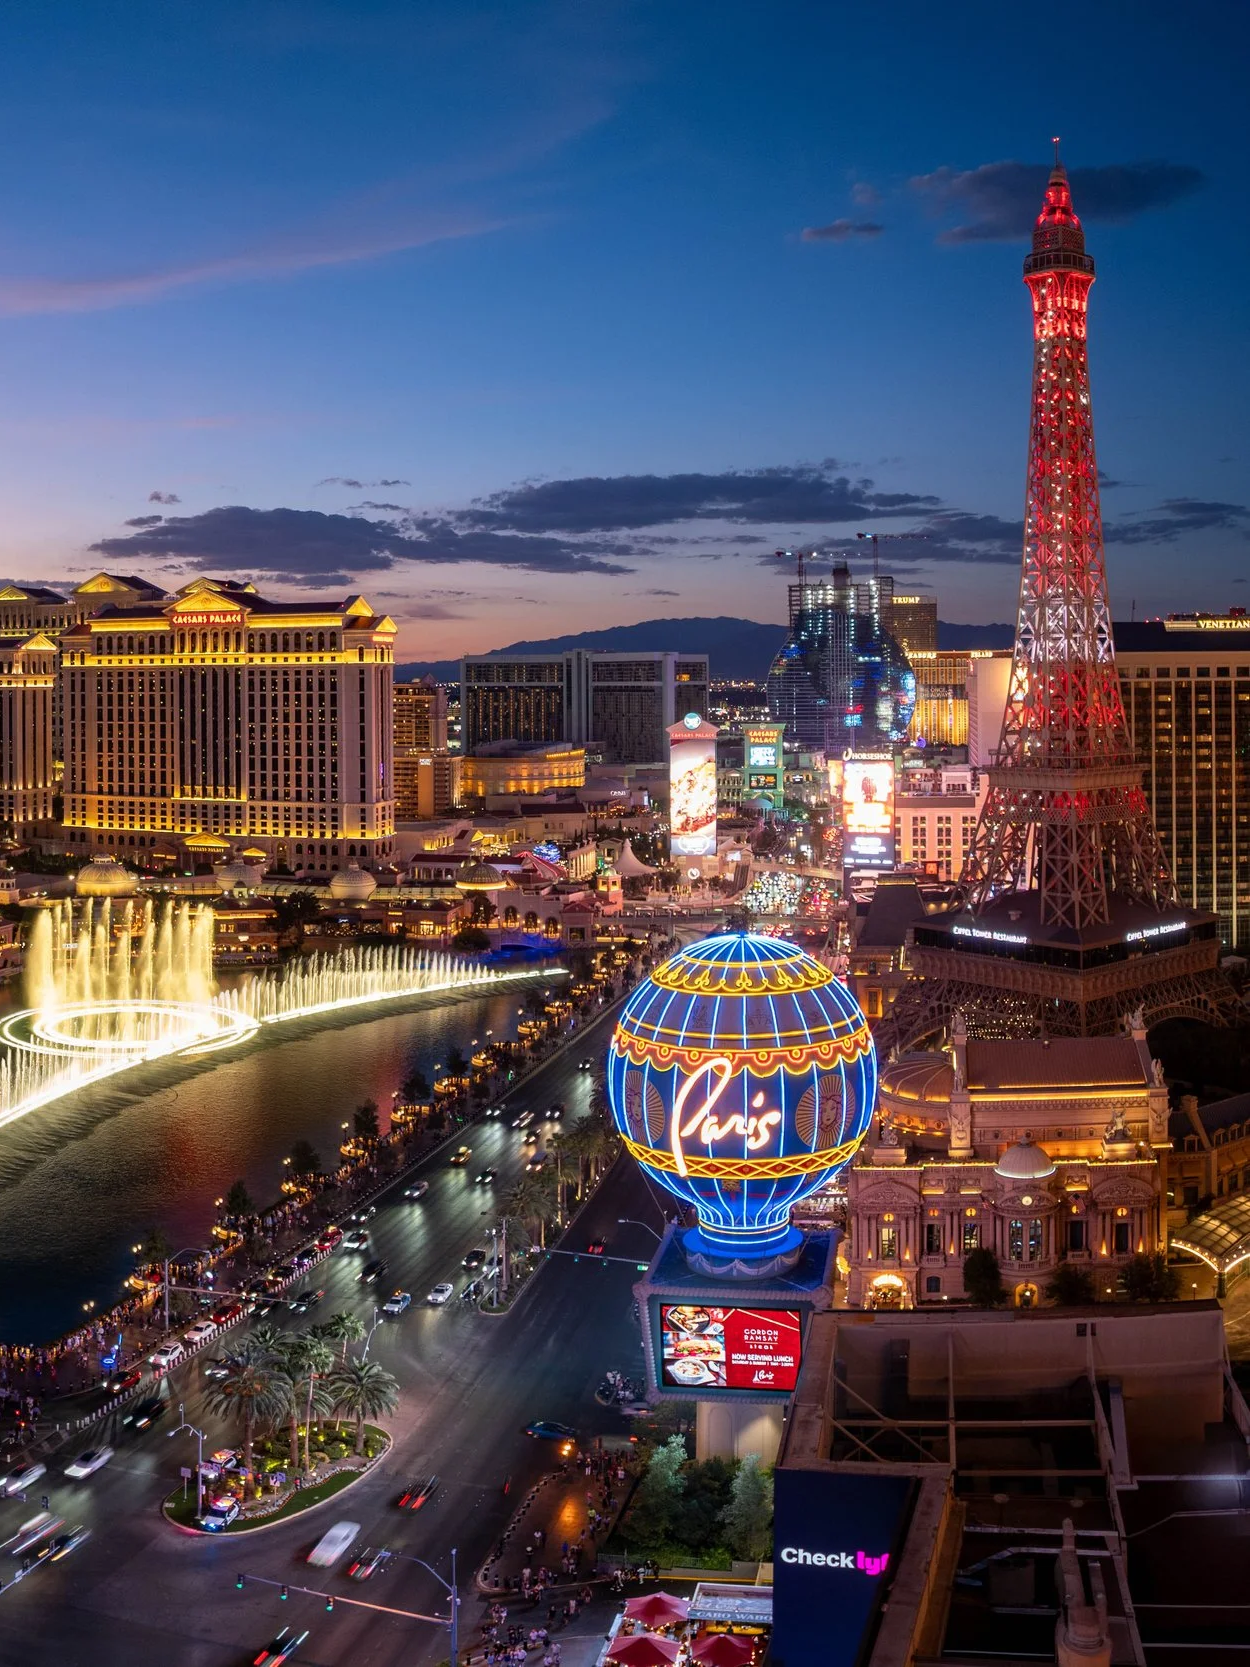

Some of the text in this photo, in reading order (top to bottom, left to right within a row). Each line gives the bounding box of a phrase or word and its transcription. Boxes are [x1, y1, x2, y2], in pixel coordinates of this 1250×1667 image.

[892, 596, 920, 604] TRUMP
[173, 614, 241, 624] CAESARS PALACE
[952, 926, 1027, 944] EIFFEL TOWER RESTAURANT
[1127, 921, 1186, 942] EIFFEL TOWER RESTAURANT
[671, 1057, 782, 1178] Paris
[747, 1353, 773, 1361] SERVING
[773, 1355, 794, 1363] LUNCH
[759, 1369, 774, 1380] Paris
[781, 1547, 855, 1569] Check
[696, 1610, 773, 1621] CABO WABO
